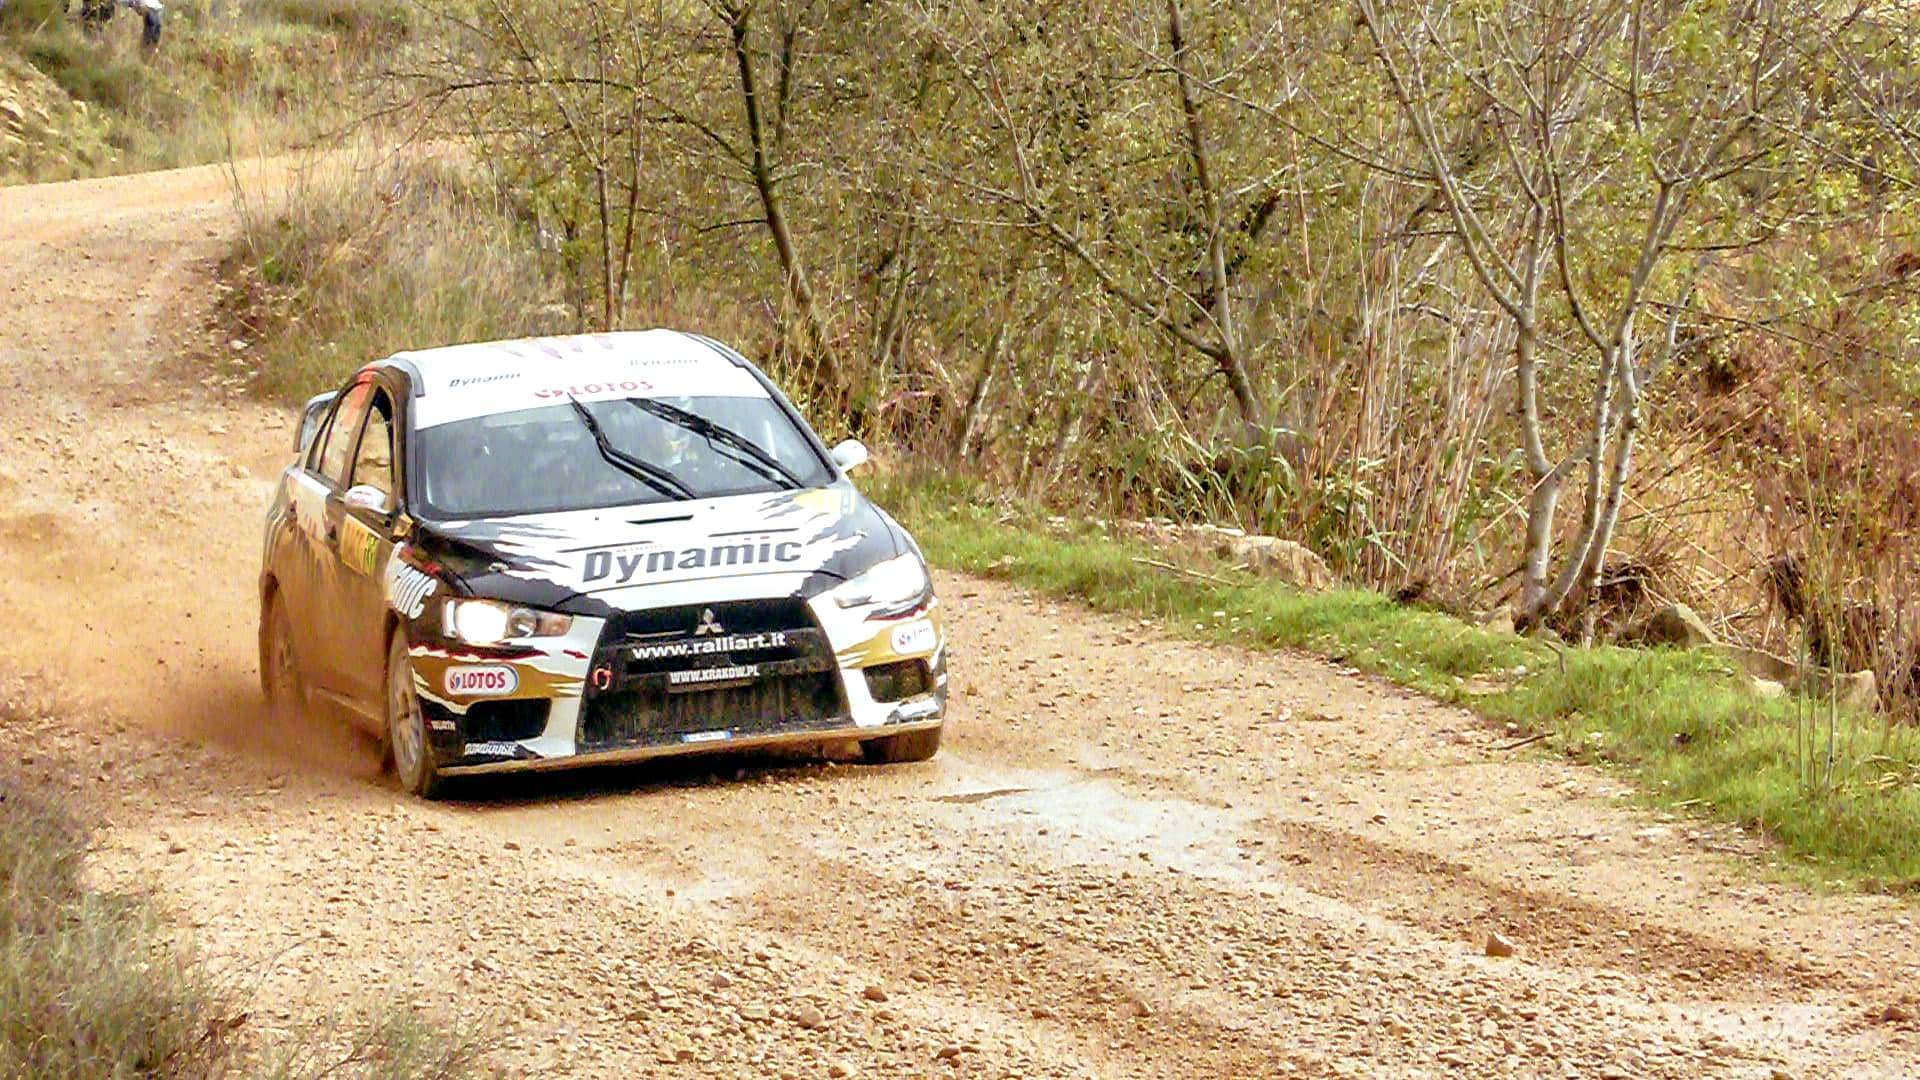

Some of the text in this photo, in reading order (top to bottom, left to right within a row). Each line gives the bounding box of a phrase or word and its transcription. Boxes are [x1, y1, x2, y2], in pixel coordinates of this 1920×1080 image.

[569, 381, 653, 397] LOTOS
[582, 536, 802, 584] Dynamic
[462, 671, 506, 689] LOTOS
